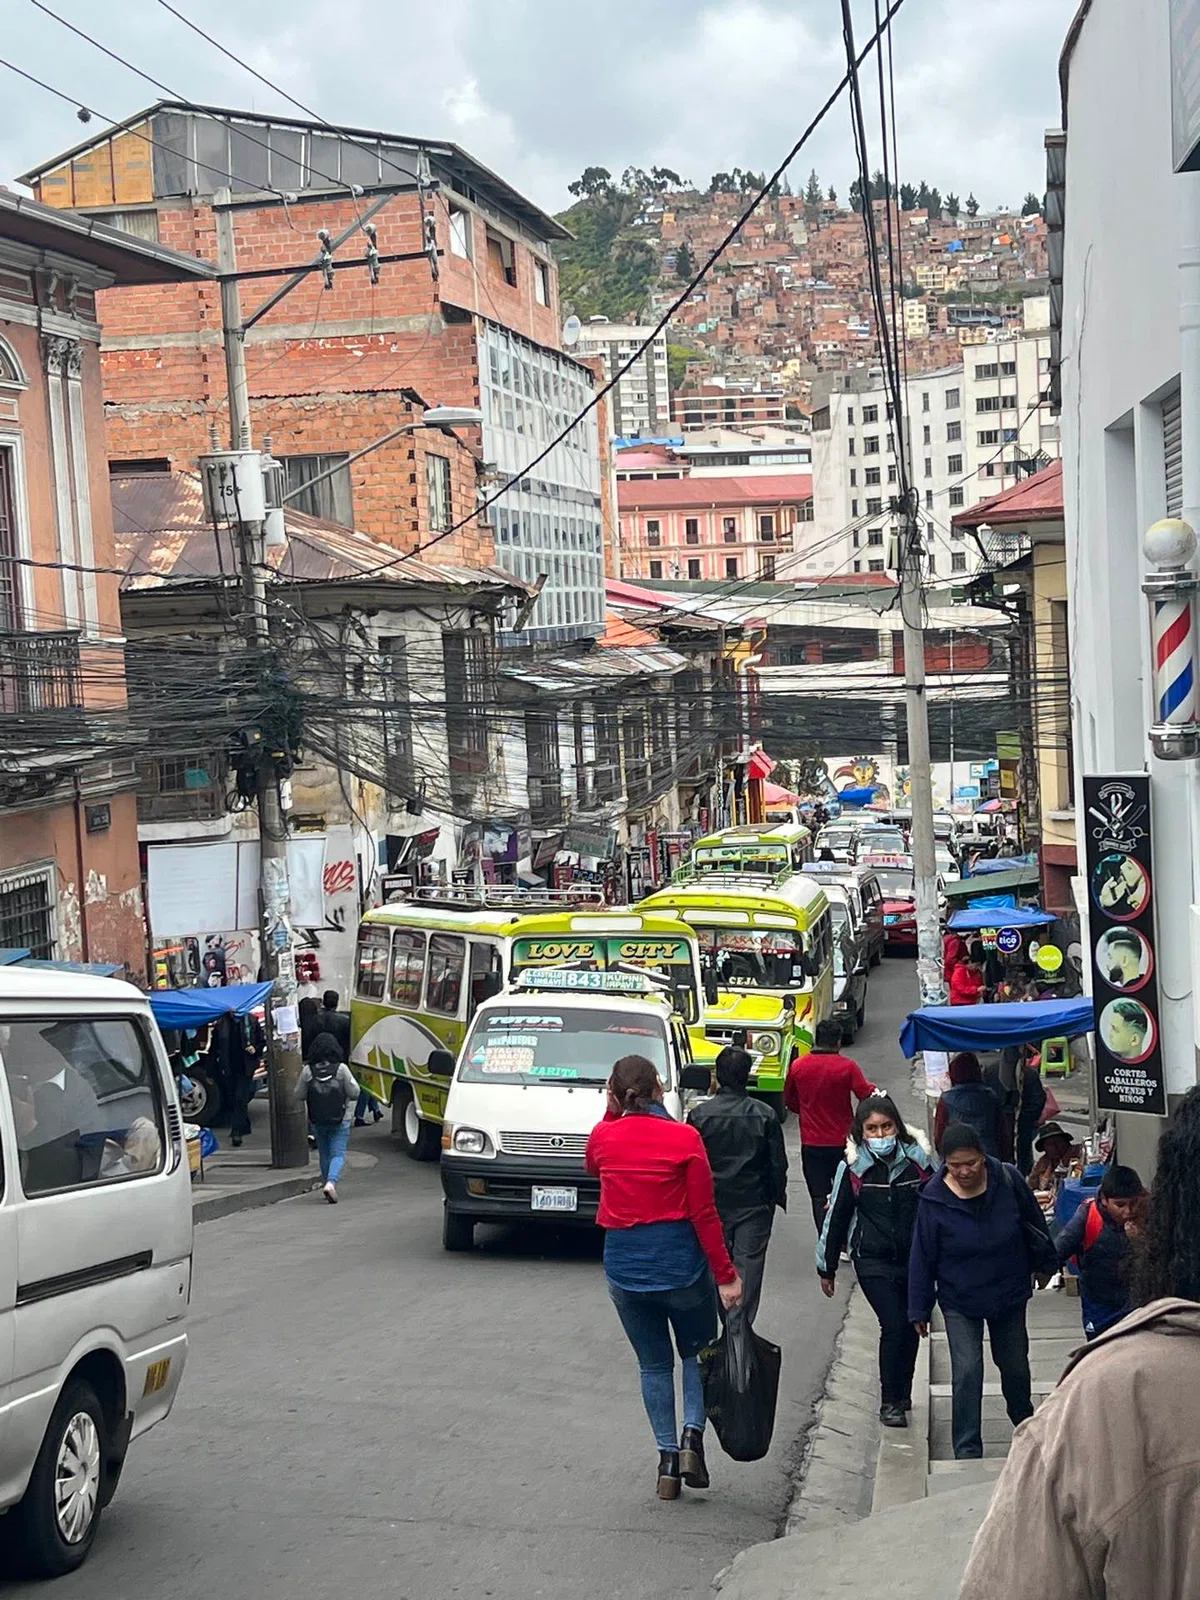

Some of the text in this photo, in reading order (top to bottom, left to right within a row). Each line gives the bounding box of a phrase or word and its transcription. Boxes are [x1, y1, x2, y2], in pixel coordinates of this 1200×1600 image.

[528, 943, 680, 959] LOVE CITY
[567, 972, 600, 987] 843
[729, 976, 758, 986] CEJA
[1113, 1068, 1147, 1078] CORTES
[1104, 1076, 1158, 1088] CABALLEROS
[1146, 1087, 1154, 1097] Y
[1119, 1093, 1145, 1104] NIÑOS
